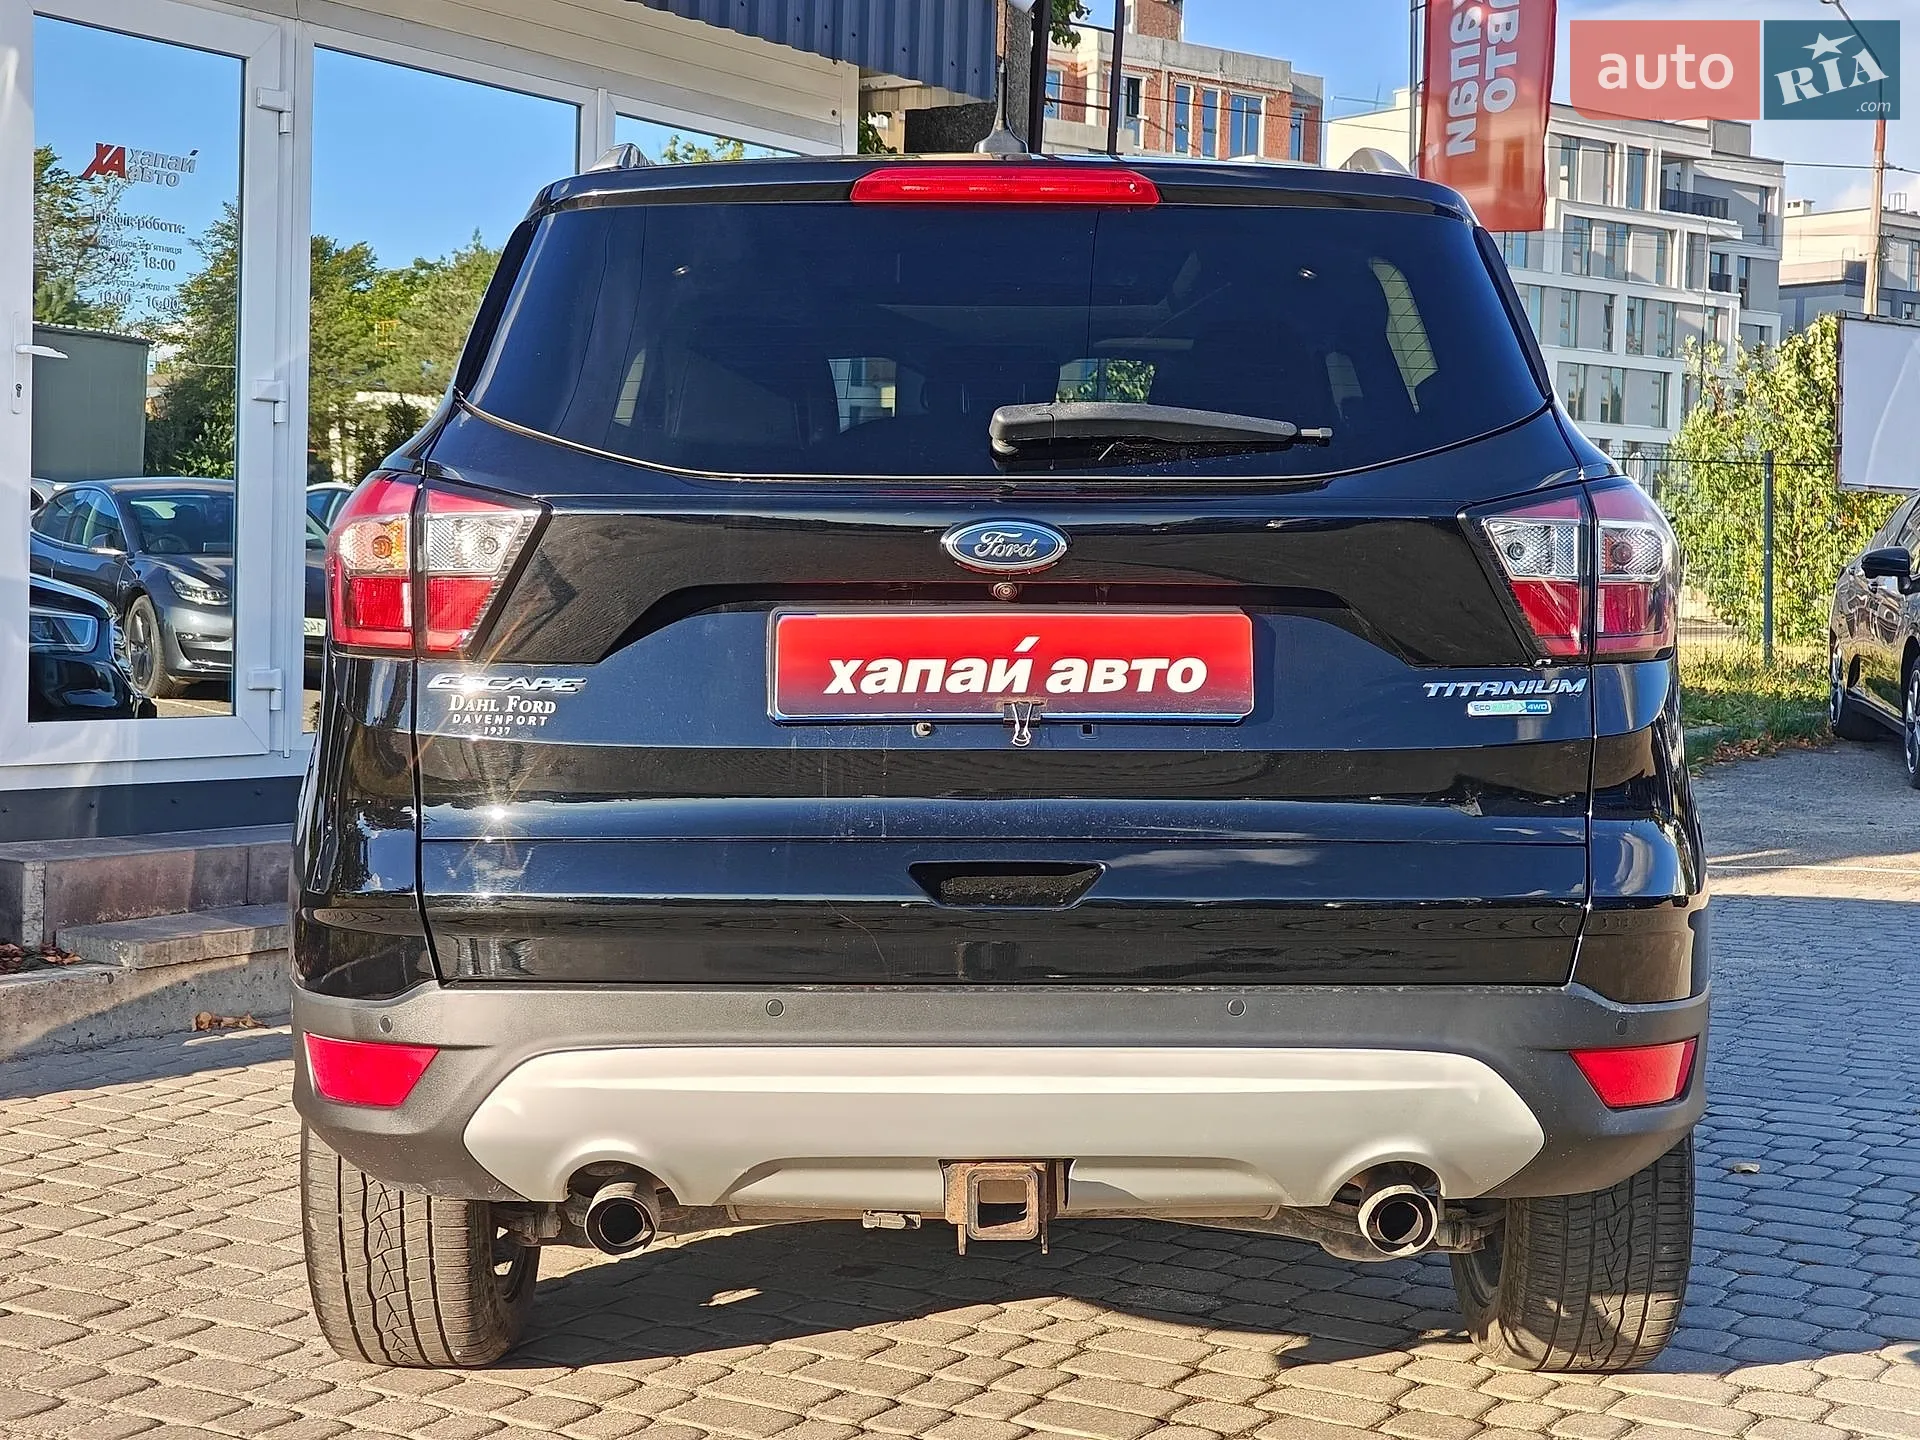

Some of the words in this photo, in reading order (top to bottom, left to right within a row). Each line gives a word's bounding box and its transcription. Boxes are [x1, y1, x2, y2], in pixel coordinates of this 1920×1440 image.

[127, 164, 181, 188] авто
[143, 255, 176, 272] 18:00
[973, 530, 1039, 558] Ford
[823, 636, 1040, 695] хапай
[1044, 656, 1208, 695] авто
[1423, 677, 1588, 698] TITANIUM
[448, 694, 500, 713] DAHL
[504, 695, 557, 715] FORD
[1526, 703, 1548, 711] 4WD
[452, 713, 549, 727] DAVENPORT
[483, 726, 511, 736] 1937
